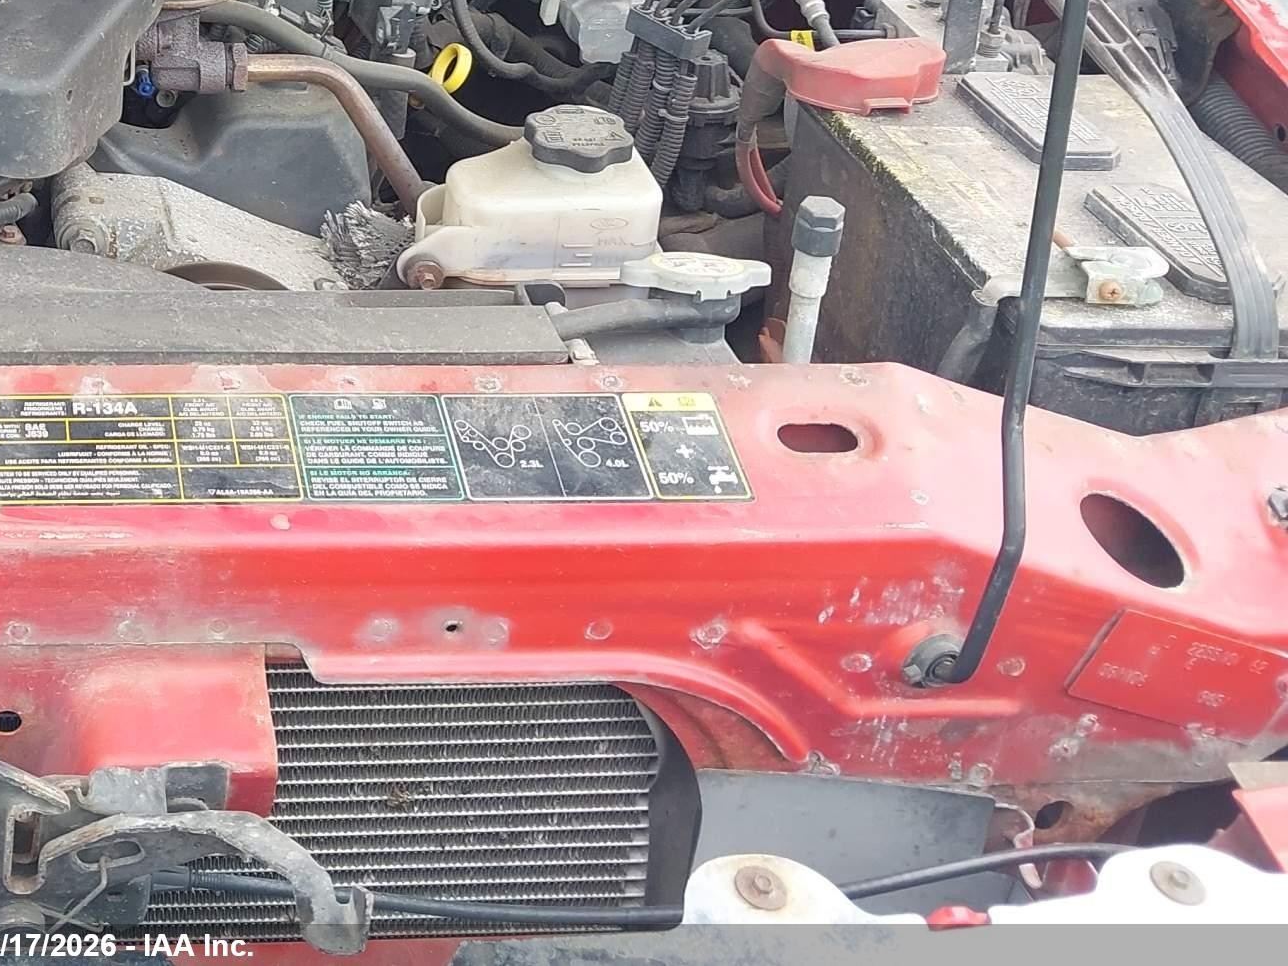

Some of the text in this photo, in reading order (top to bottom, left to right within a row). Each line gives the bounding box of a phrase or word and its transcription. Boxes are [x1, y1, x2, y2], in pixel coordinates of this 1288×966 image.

[72, 401, 138, 415] R-134A
[639, 421, 675, 433] 50%
[25, 430, 49, 438] J639
[520, 460, 544, 468] 2.3L
[605, 459, 630, 468] 4.0L
[658, 473, 695, 484] 50%
